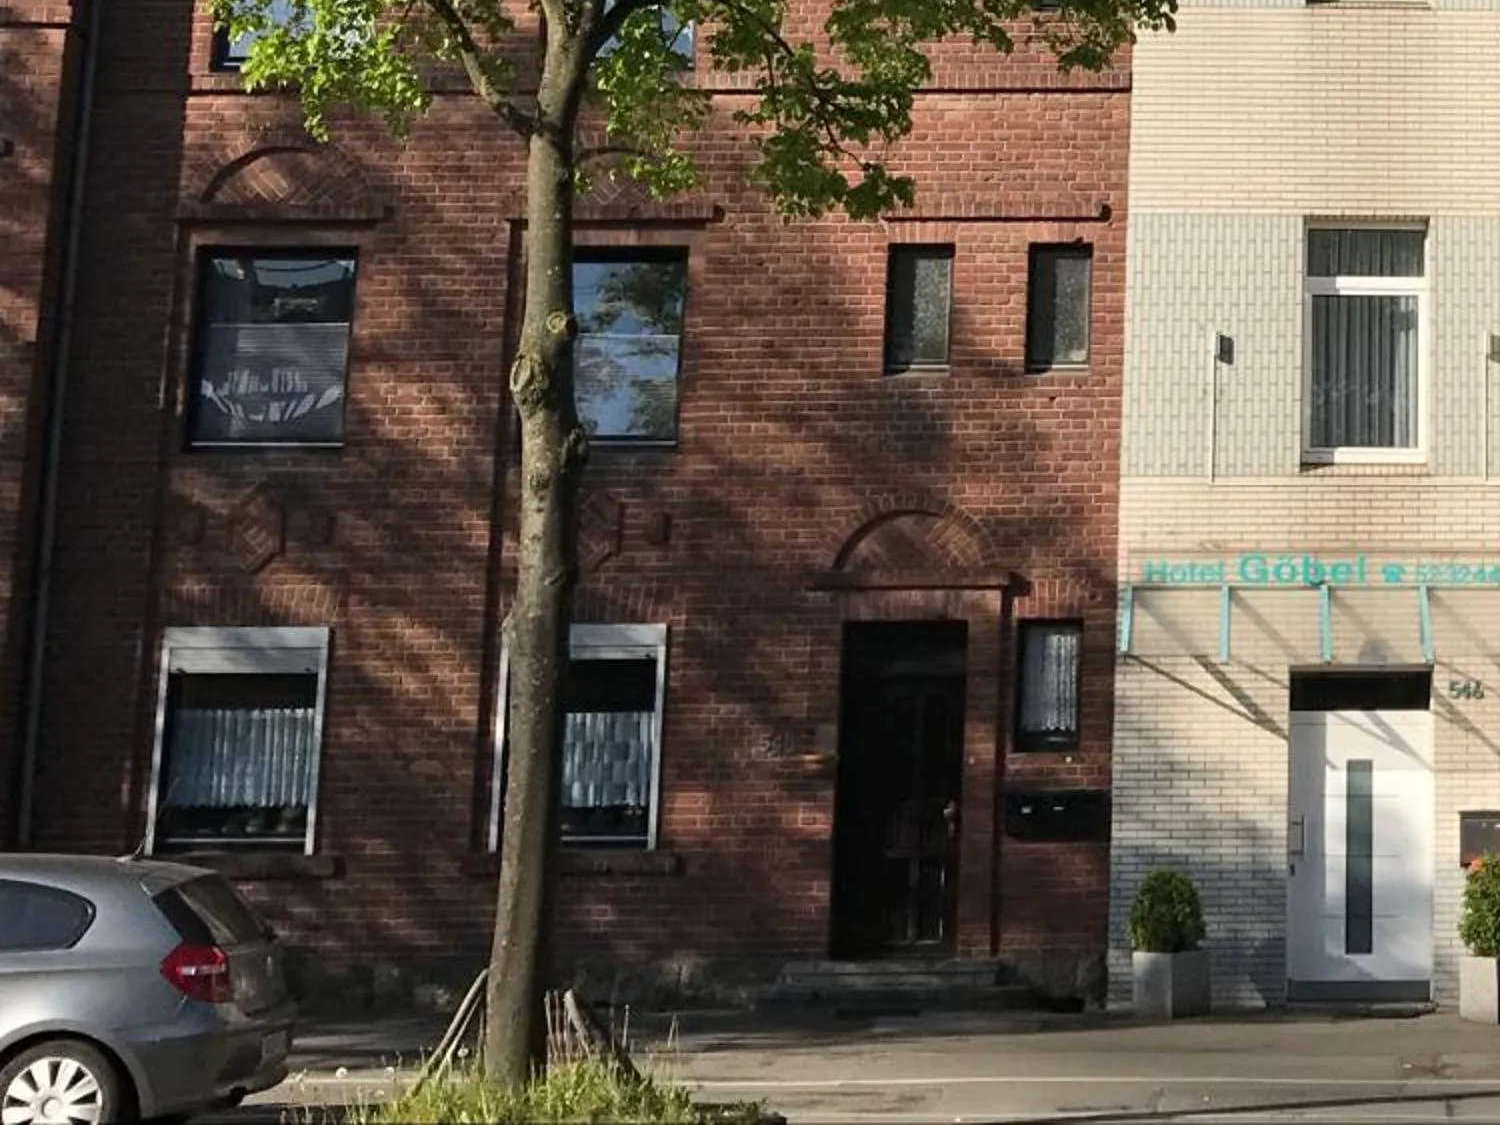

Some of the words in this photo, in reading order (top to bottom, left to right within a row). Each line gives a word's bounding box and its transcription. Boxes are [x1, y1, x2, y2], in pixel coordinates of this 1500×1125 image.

[1143, 559, 1225, 584] Hotel
[1239, 553, 1366, 586] Göbel
[1449, 681, 1485, 700] 546
